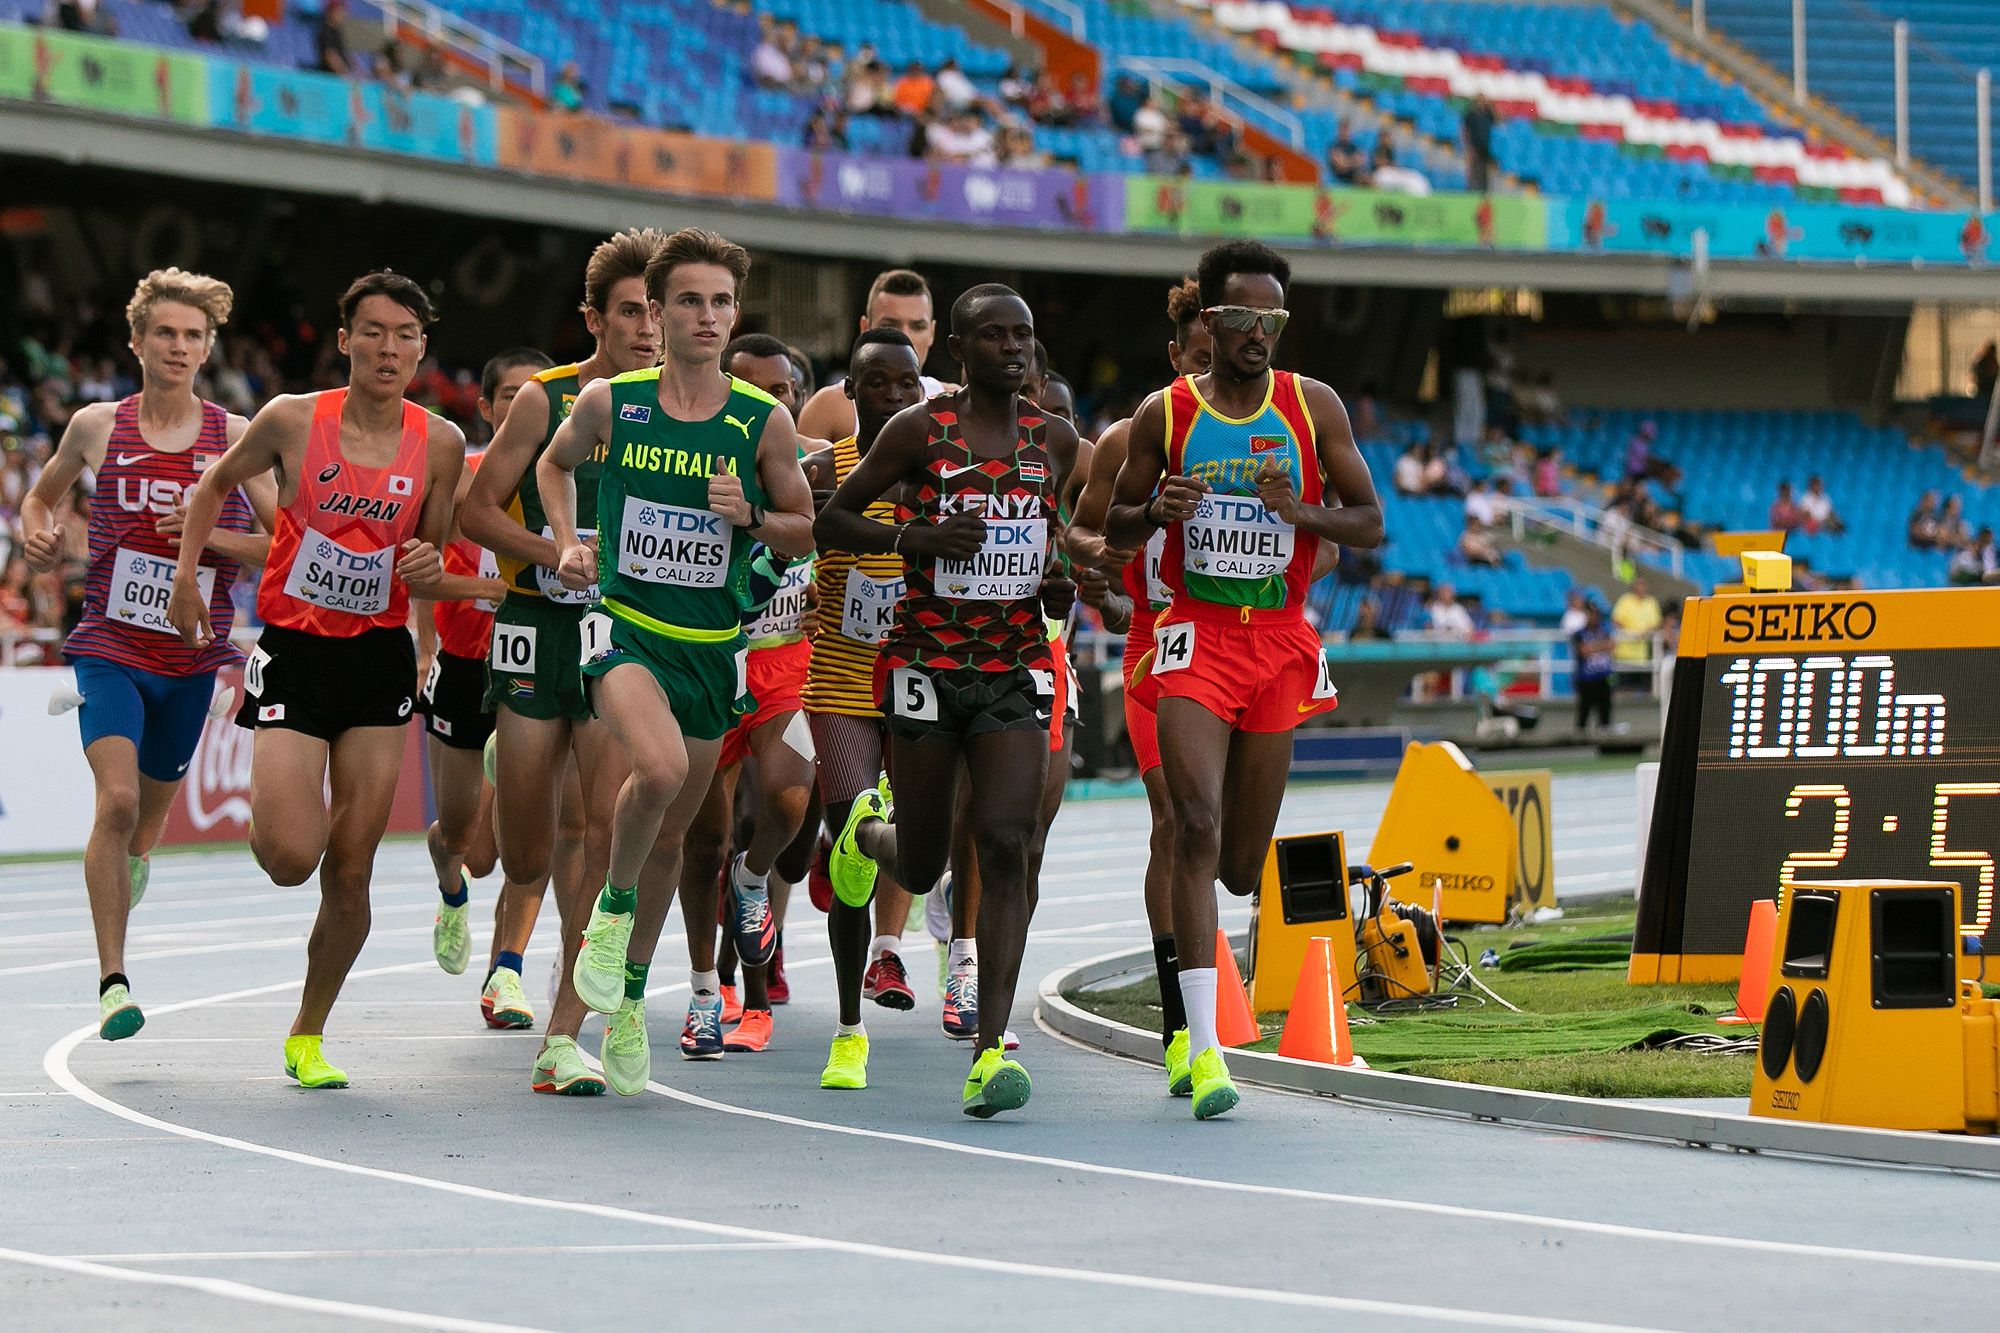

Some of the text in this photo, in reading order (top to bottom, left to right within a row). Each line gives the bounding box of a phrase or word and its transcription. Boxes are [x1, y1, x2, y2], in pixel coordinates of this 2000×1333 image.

[621, 442, 738, 479] AUSTRALA
[319, 492, 401, 521] JAPAN
[938, 494, 1041, 519] KENYA
[1214, 501, 1278, 525] TDK
[657, 509, 721, 536] TDK
[626, 529, 724, 567] NOAKES
[1188, 525, 1286, 558] SAMUEL
[334, 546, 384, 572] TDK
[942, 552, 1040, 577] MANDELA
[1216, 560, 1277, 576] CALI 22
[305, 561, 381, 598] SATOH
[655, 566, 716, 584] CALI 22
[124, 580, 171, 611] GOR
[325, 595, 379, 612] CALI 22
[977, 583, 1032, 597] CALI 22
[142, 612, 174, 629] CAL
[850, 597, 868, 624] R.
[1723, 601, 1877, 643] SEIKO
[587, 620, 596, 650] 1
[761, 620, 791, 634] CALI
[498, 634, 531, 666] 10
[1160, 631, 1187, 666] 14
[249, 655, 261, 688] 11
[906, 676, 926, 712] 5
[1720, 655, 1946, 759] 1000m
[1419, 871, 1495, 892] SEIKO
[1771, 1089, 1800, 1111] SEIKO
